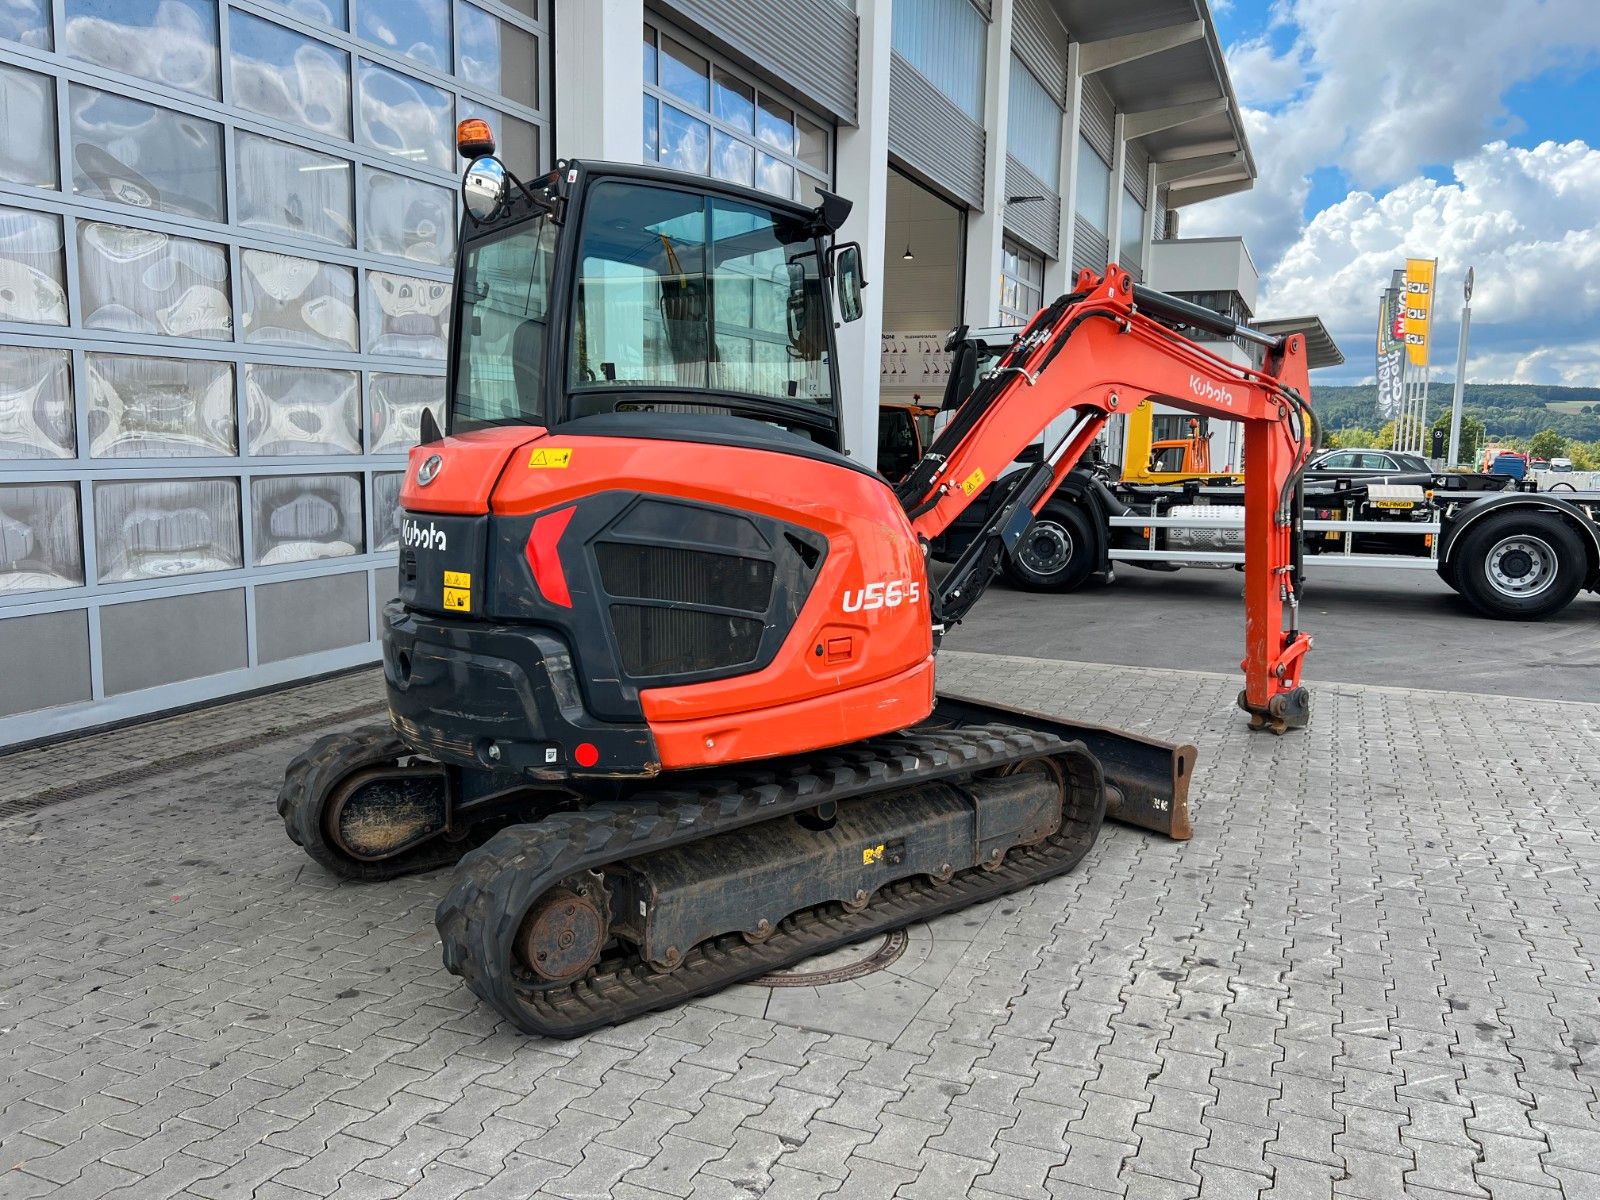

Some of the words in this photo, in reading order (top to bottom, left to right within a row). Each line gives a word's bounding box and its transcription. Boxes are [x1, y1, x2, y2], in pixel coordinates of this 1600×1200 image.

[1189, 374, 1233, 407] Kubota
[402, 519, 447, 551] Kubota
[842, 580, 920, 613] U56-5
